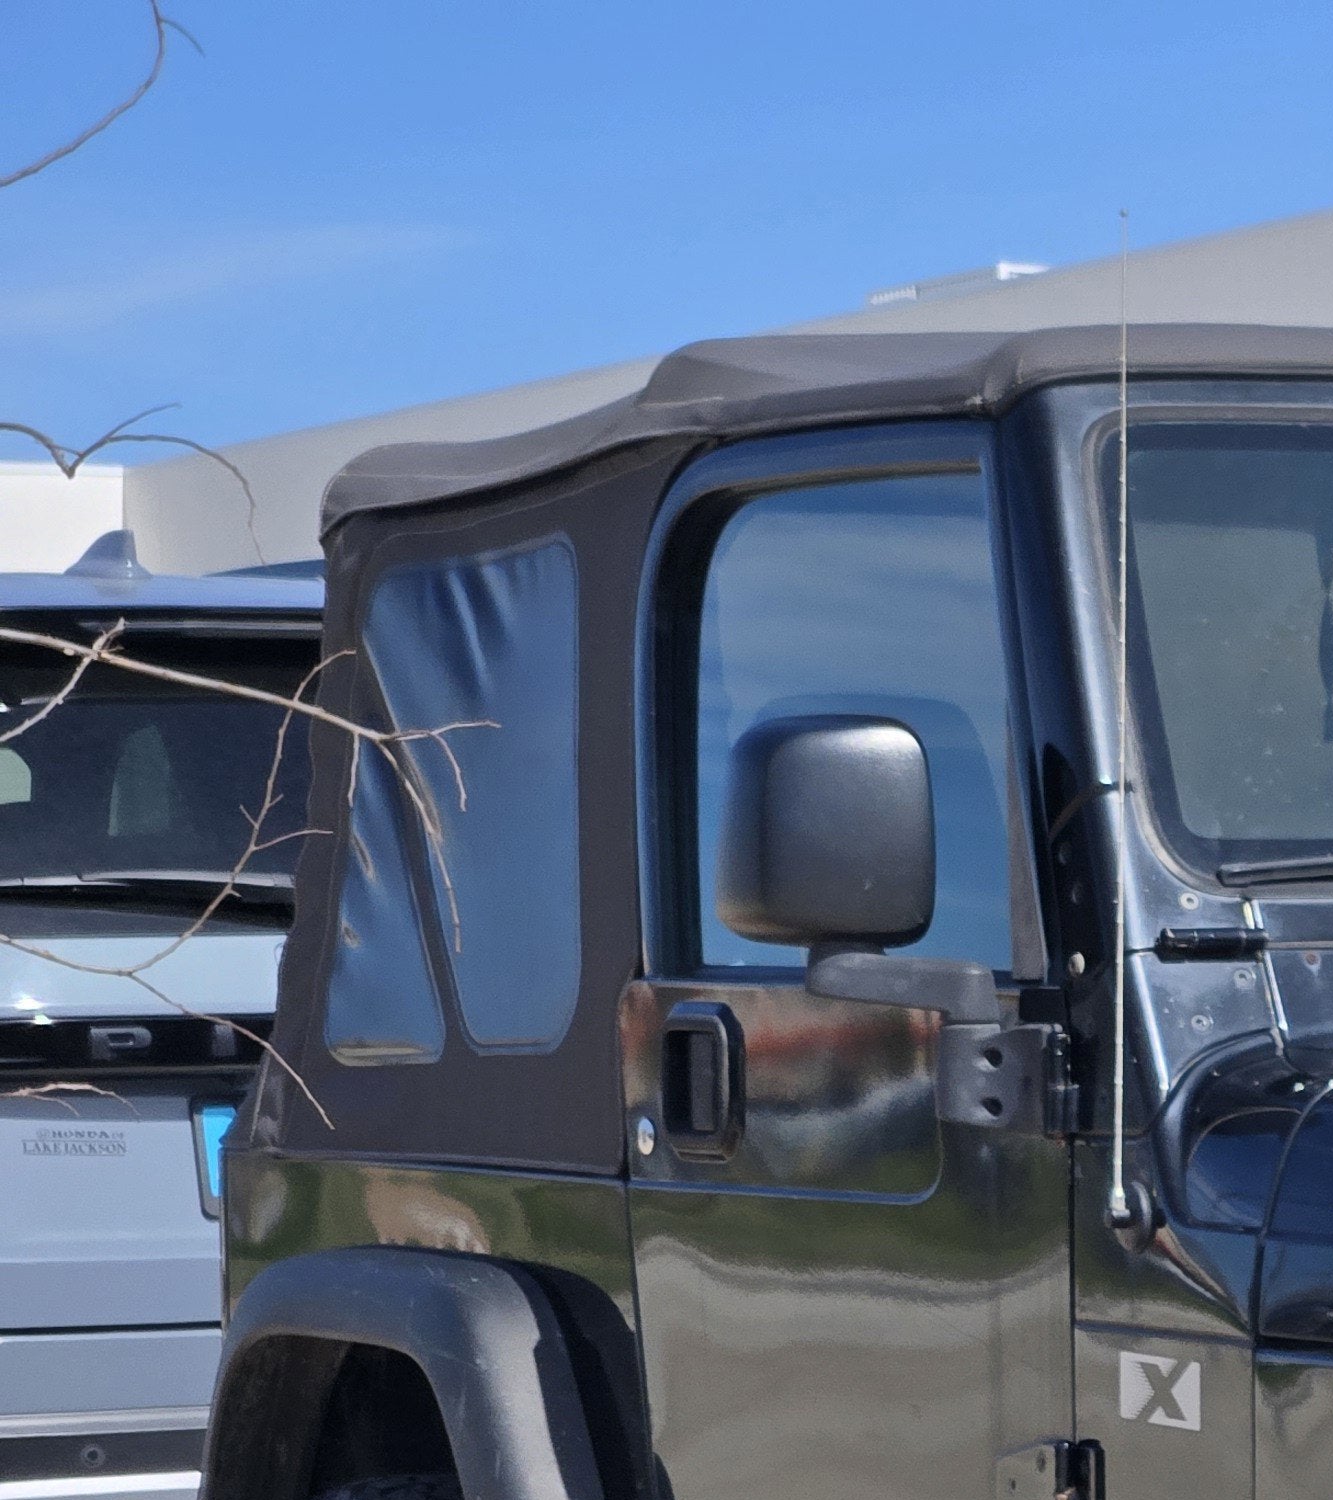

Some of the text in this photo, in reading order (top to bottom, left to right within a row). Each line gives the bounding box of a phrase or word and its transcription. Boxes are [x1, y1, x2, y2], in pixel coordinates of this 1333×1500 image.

[52, 1130, 110, 1139] HONDA
[23, 1141, 127, 1155] LAKE JACKSON
